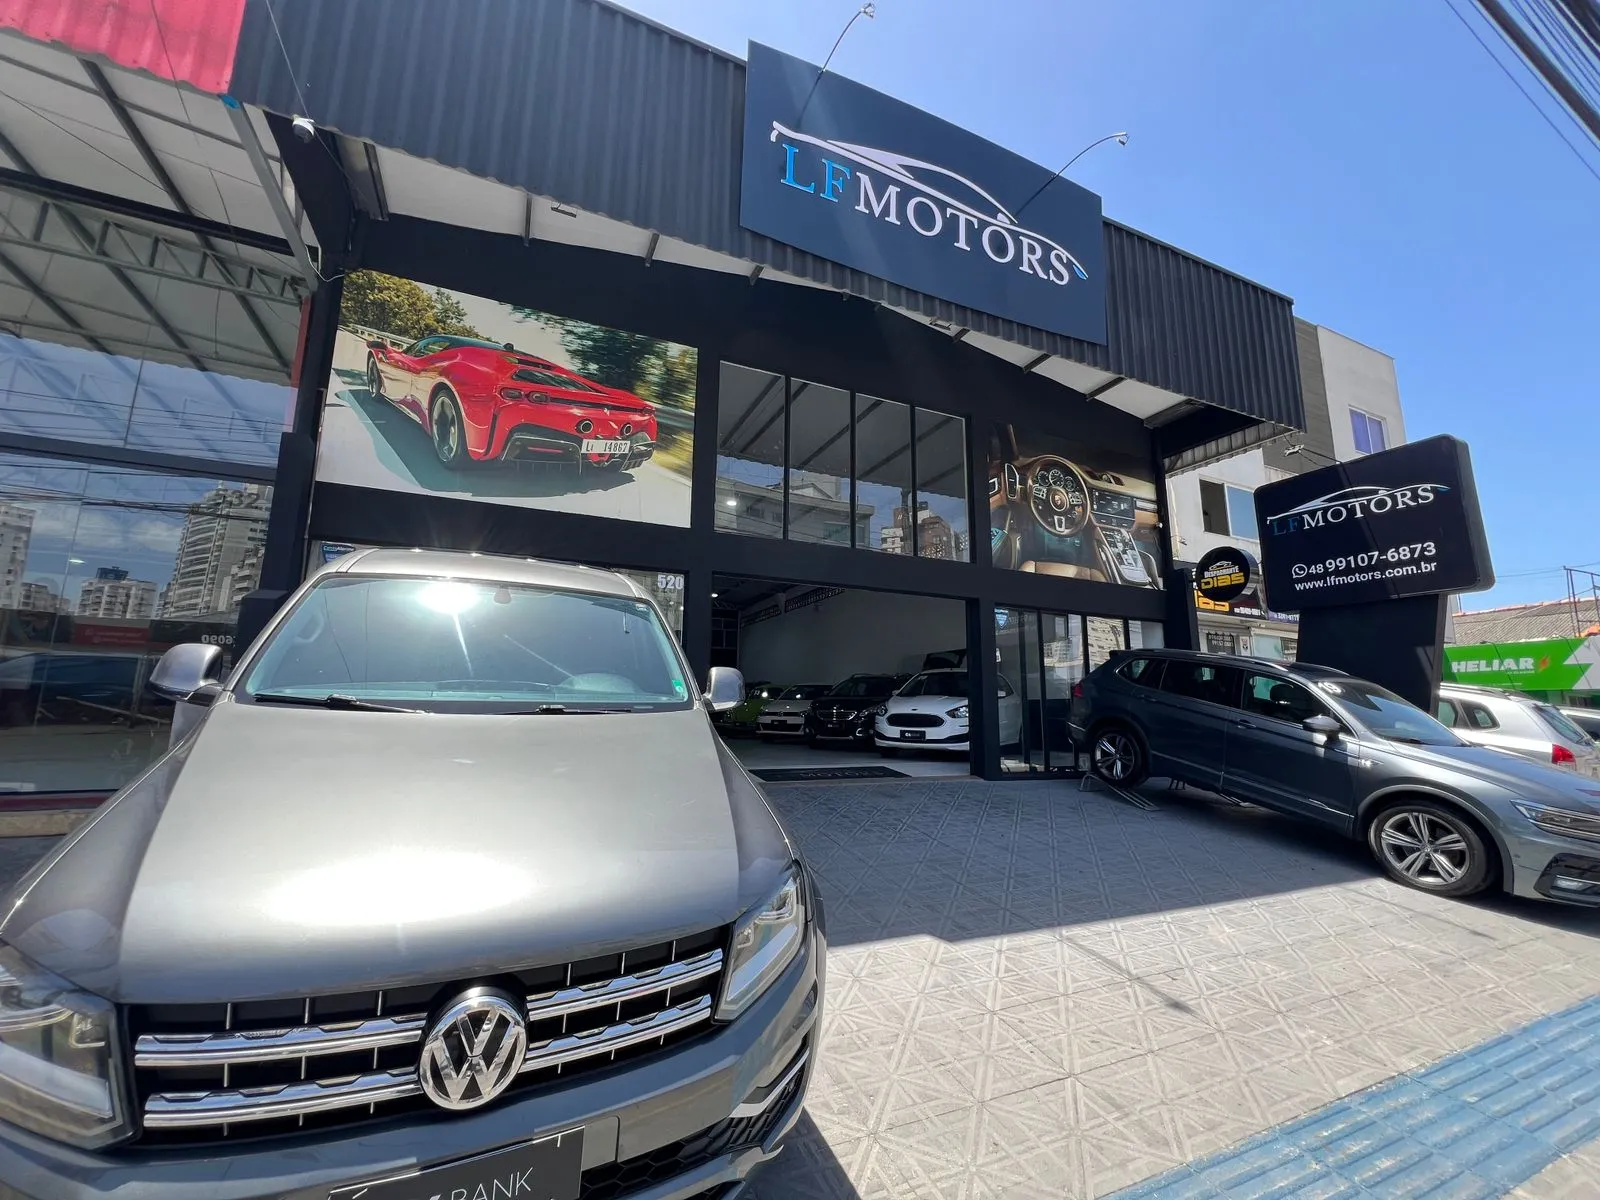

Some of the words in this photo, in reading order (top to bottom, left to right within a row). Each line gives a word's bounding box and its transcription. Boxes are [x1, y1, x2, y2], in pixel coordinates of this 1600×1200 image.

[1308, 564, 1324, 575] 48
[1325, 541, 1437, 572] 99107-6873
[657, 574, 685, 590] 520
[1294, 561, 1438, 591] www.lfmotors.com.br
[1451, 657, 1535, 673] HELIAR
